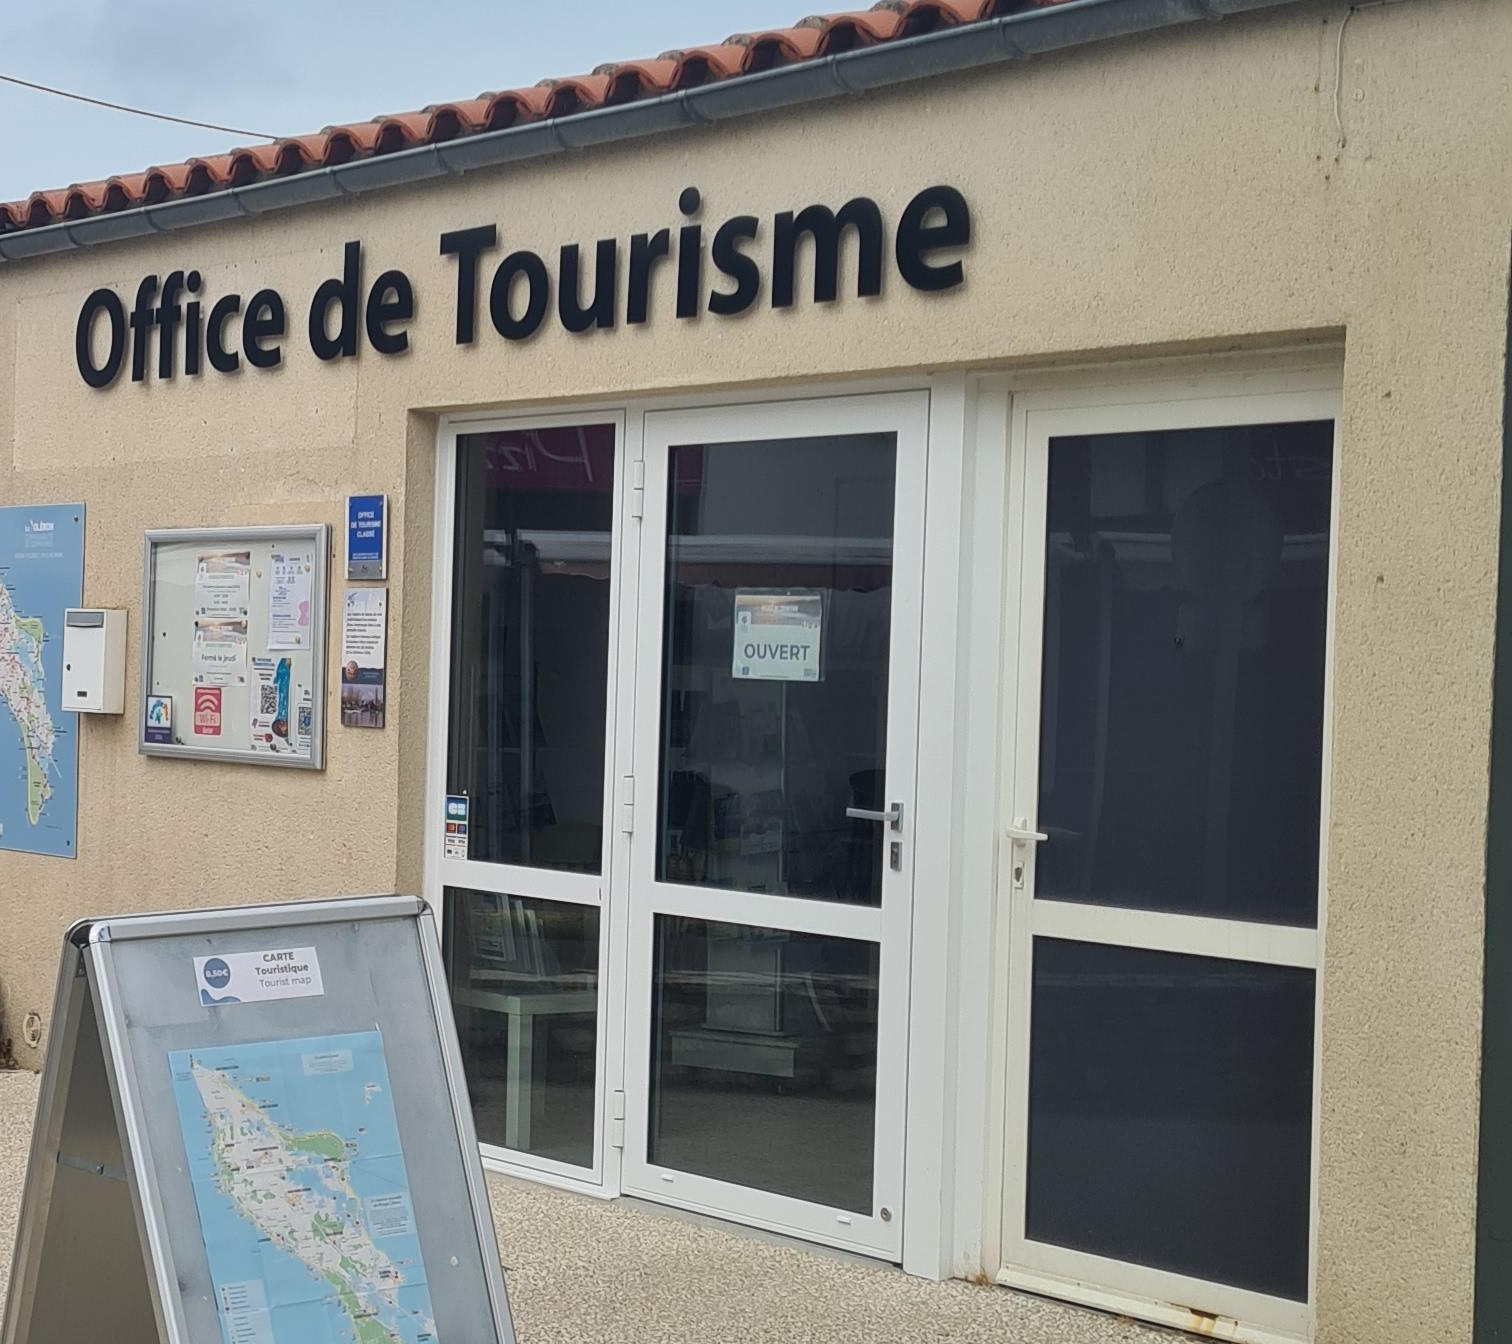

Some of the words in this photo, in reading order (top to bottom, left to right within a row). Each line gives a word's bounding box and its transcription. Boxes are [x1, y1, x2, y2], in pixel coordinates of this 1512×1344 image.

[74, 270, 285, 390] Office
[307, 240, 415, 361] de
[439, 185, 973, 346] Tourisme
[744, 643, 810, 661] OUVERT
[262, 952, 294, 962] CARTE
[254, 963, 309, 976] Touristique
[259, 977, 290, 988] Tourist
[291, 976, 312, 986] map
